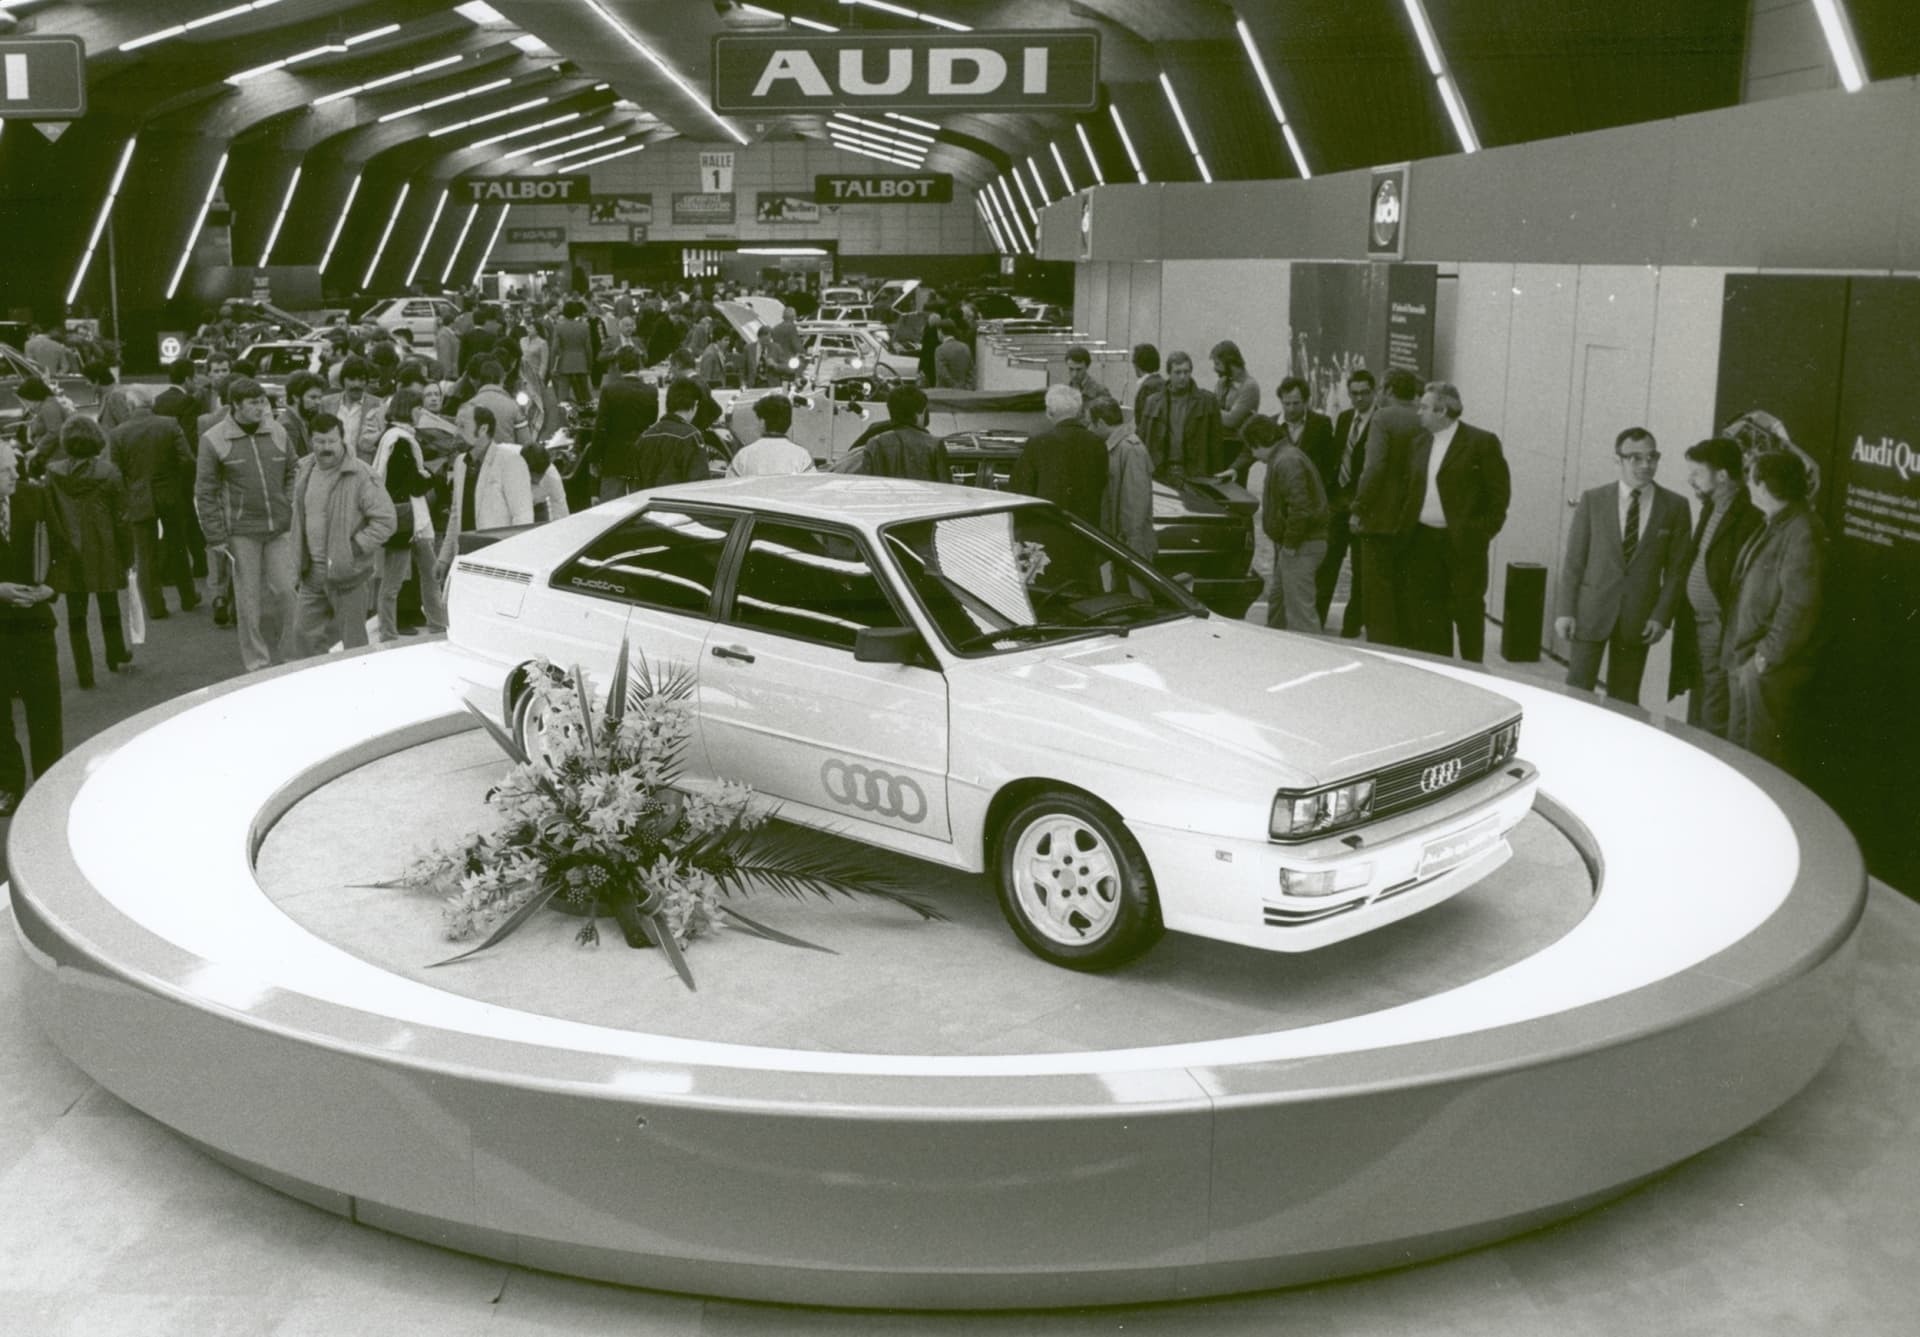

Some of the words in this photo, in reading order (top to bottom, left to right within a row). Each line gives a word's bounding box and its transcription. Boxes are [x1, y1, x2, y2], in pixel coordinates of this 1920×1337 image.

[751, 47, 1049, 96] AUDI
[702, 155, 732, 168] HALLE
[712, 169, 720, 189] 1
[830, 179, 936, 197] TALBOT
[469, 181, 575, 199] TALBOT
[1851, 434, 1893, 467] Audi
[571, 577, 626, 593] quattro
